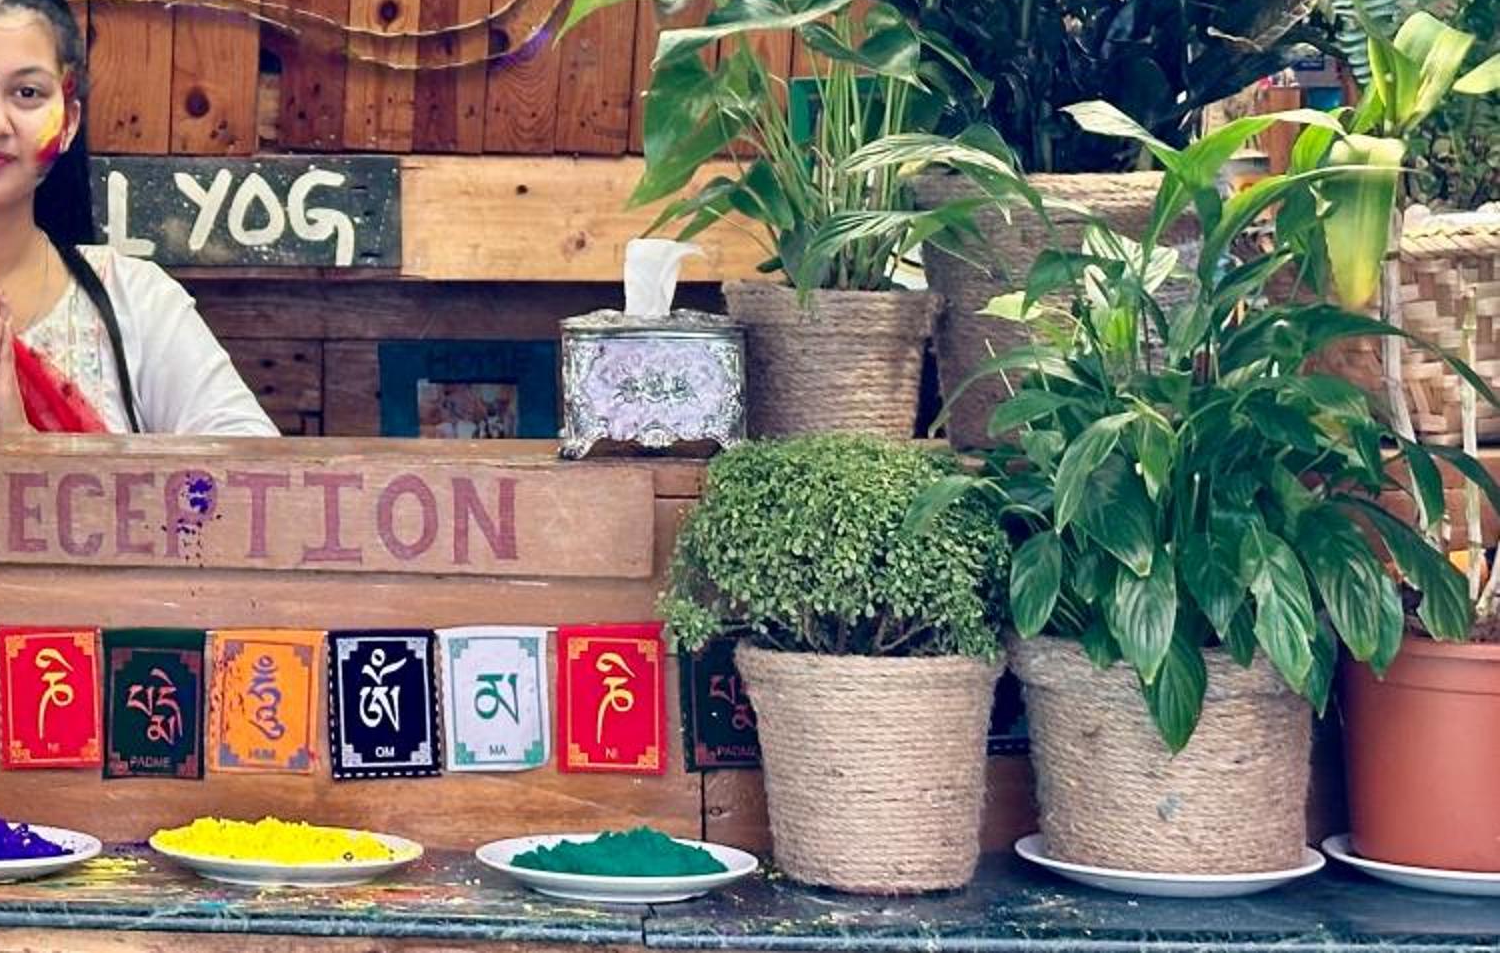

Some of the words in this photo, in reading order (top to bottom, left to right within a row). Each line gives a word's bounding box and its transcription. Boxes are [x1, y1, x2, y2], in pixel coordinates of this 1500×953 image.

[174, 167, 355, 267] YOG
[374, 746, 396, 759] OM
[129, 755, 171, 769] PADME
